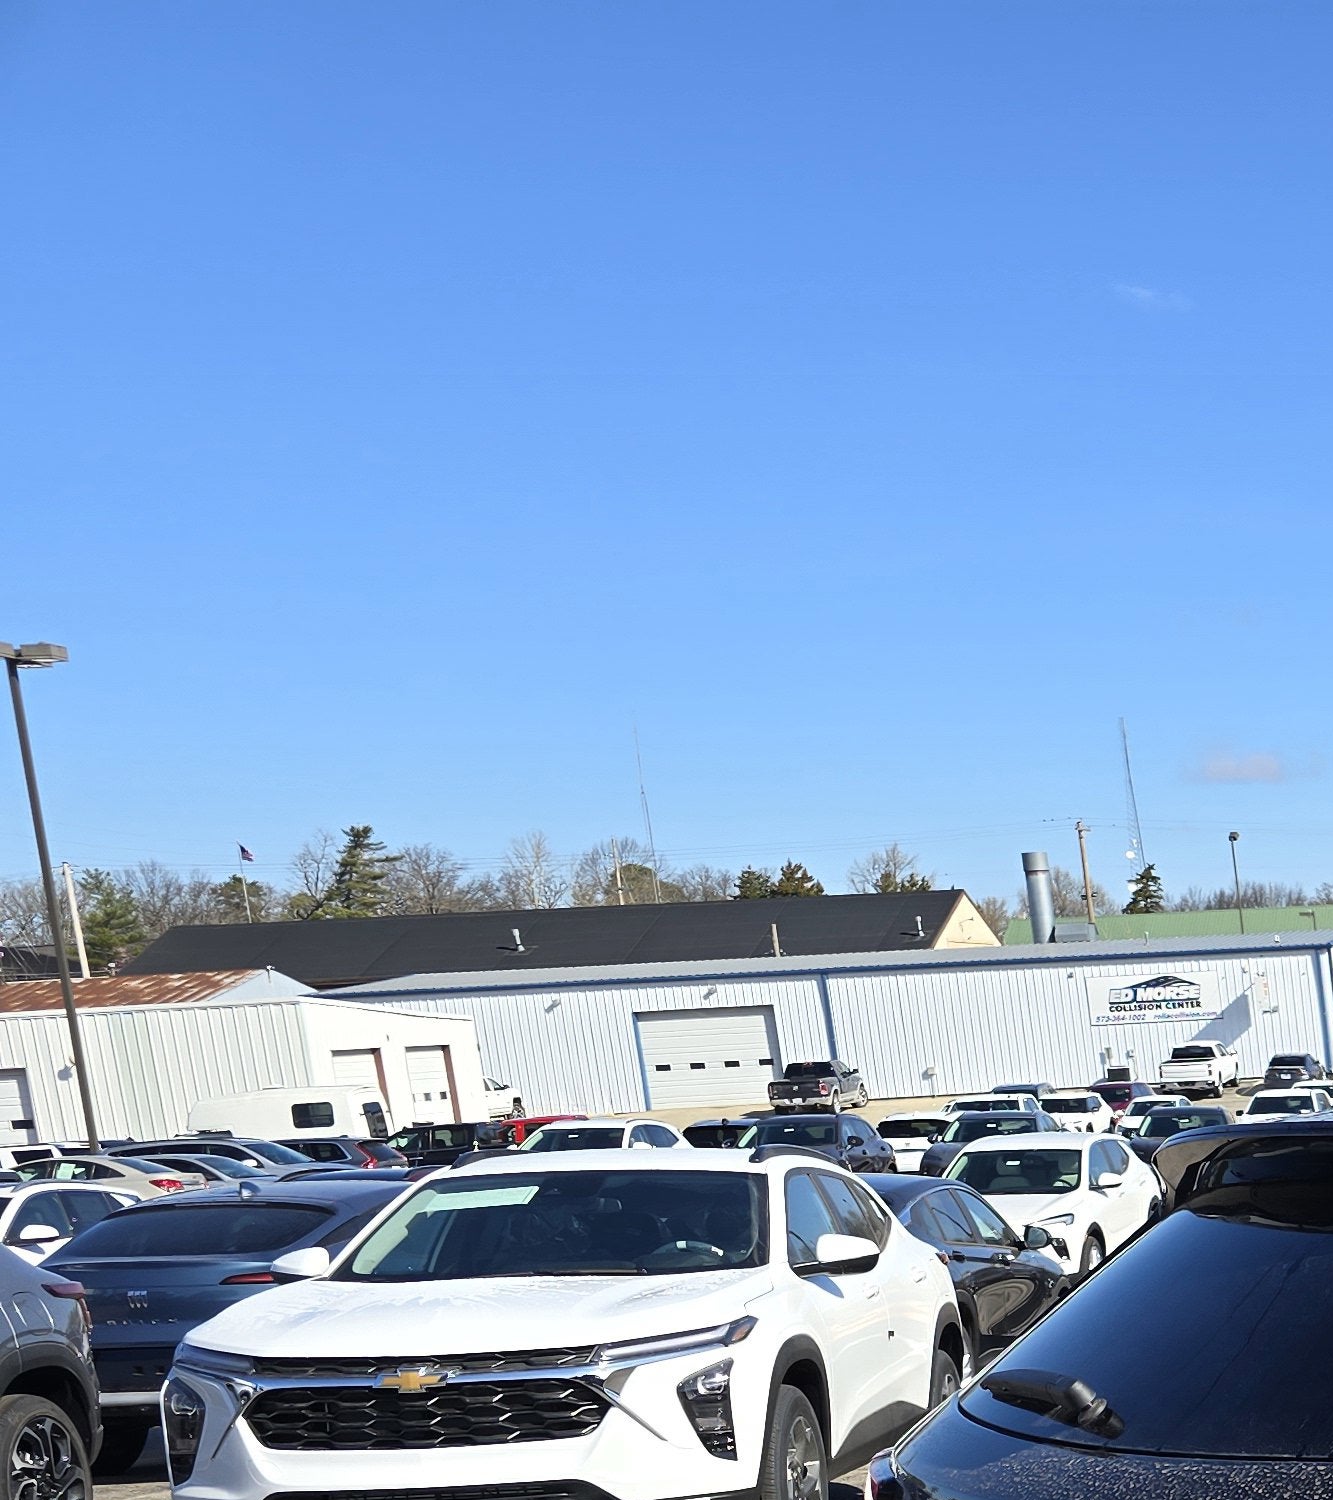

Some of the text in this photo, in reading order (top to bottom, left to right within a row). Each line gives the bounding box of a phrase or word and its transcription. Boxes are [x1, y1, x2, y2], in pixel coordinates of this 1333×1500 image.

[1109, 984, 1200, 1004] ED MORSE
[1109, 1001, 1202, 1012] COLLISION CENTER
